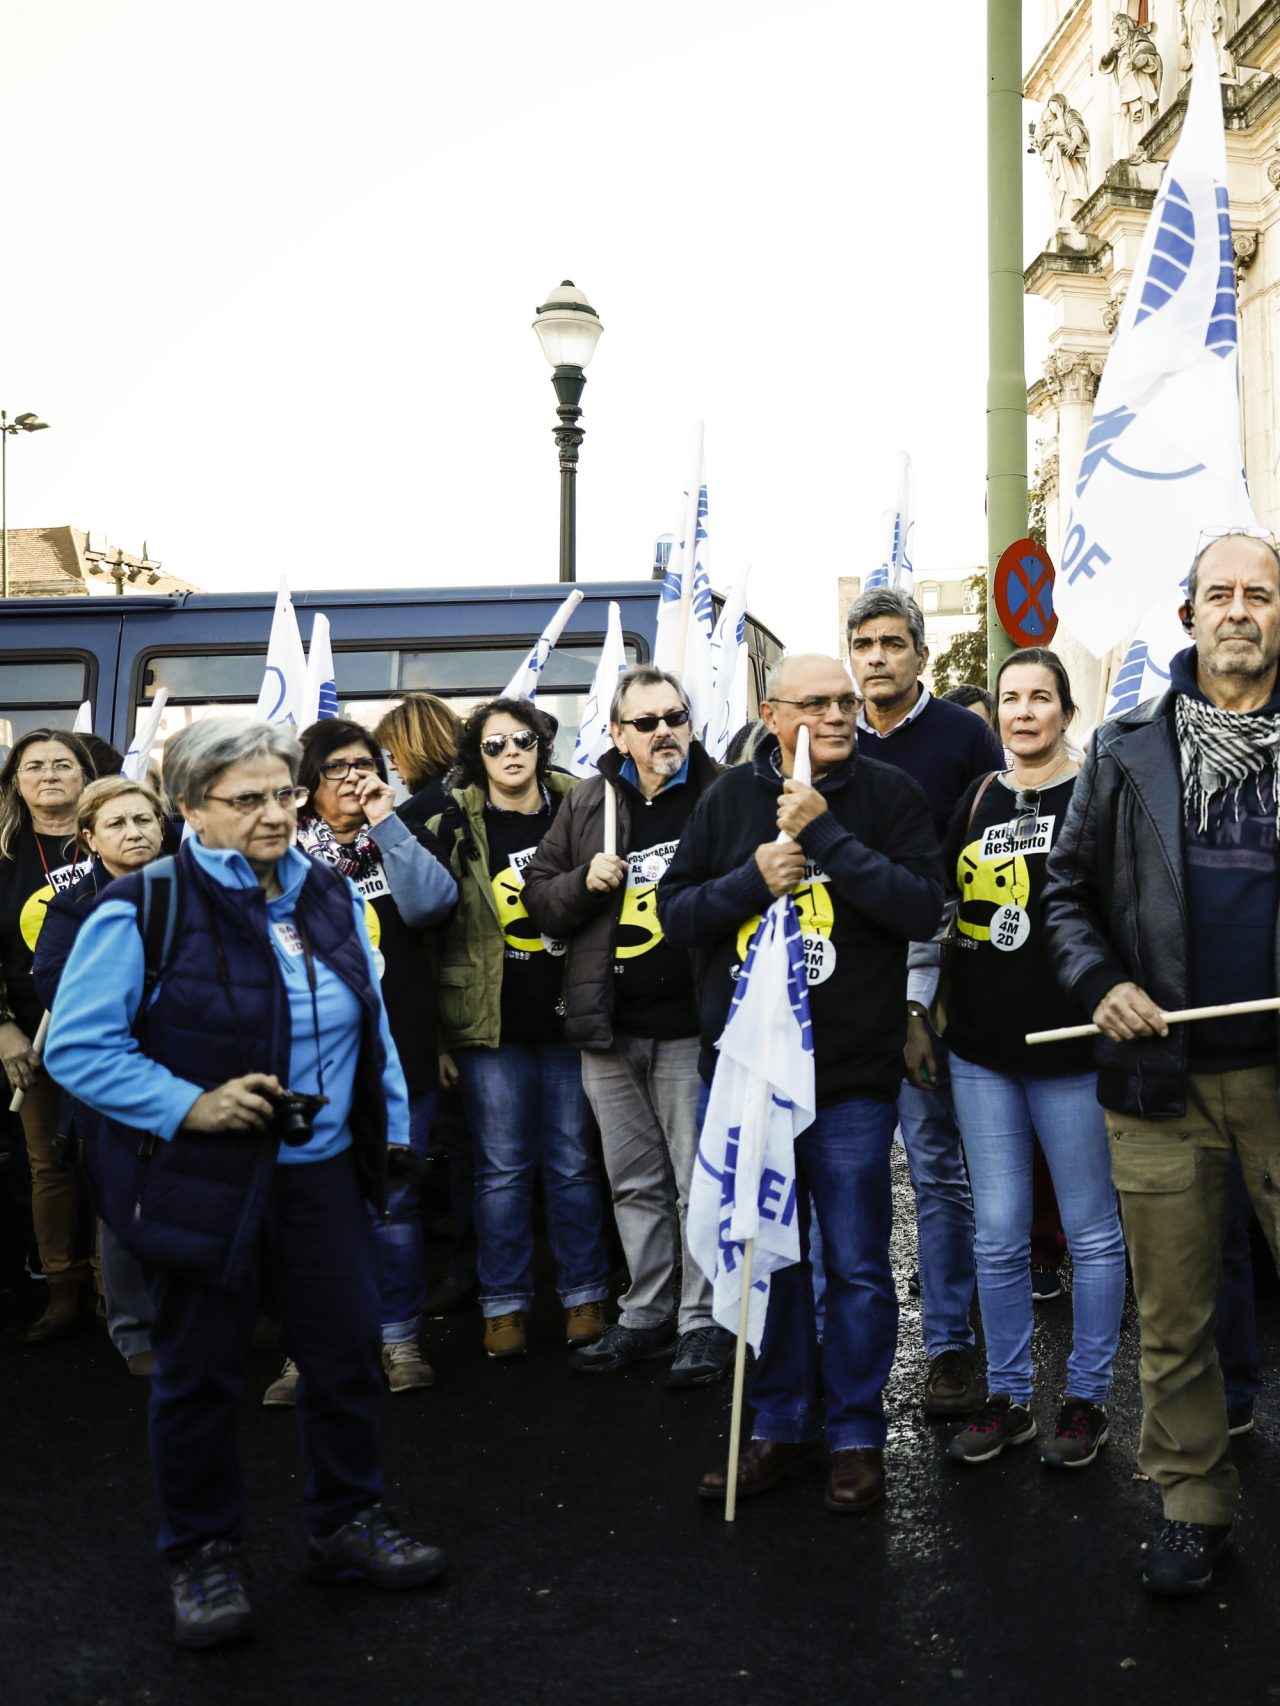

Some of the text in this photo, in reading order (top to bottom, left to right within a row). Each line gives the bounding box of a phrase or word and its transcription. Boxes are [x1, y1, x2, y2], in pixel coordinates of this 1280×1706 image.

[1061, 510, 1112, 587] OF
[984, 836, 1046, 856] Respeito
[1003, 908, 1020, 922] 9A
[999, 921, 1019, 935] 4M
[804, 938, 824, 952] 9A
[996, 933, 1014, 946] 2D
[806, 967, 820, 980] D
